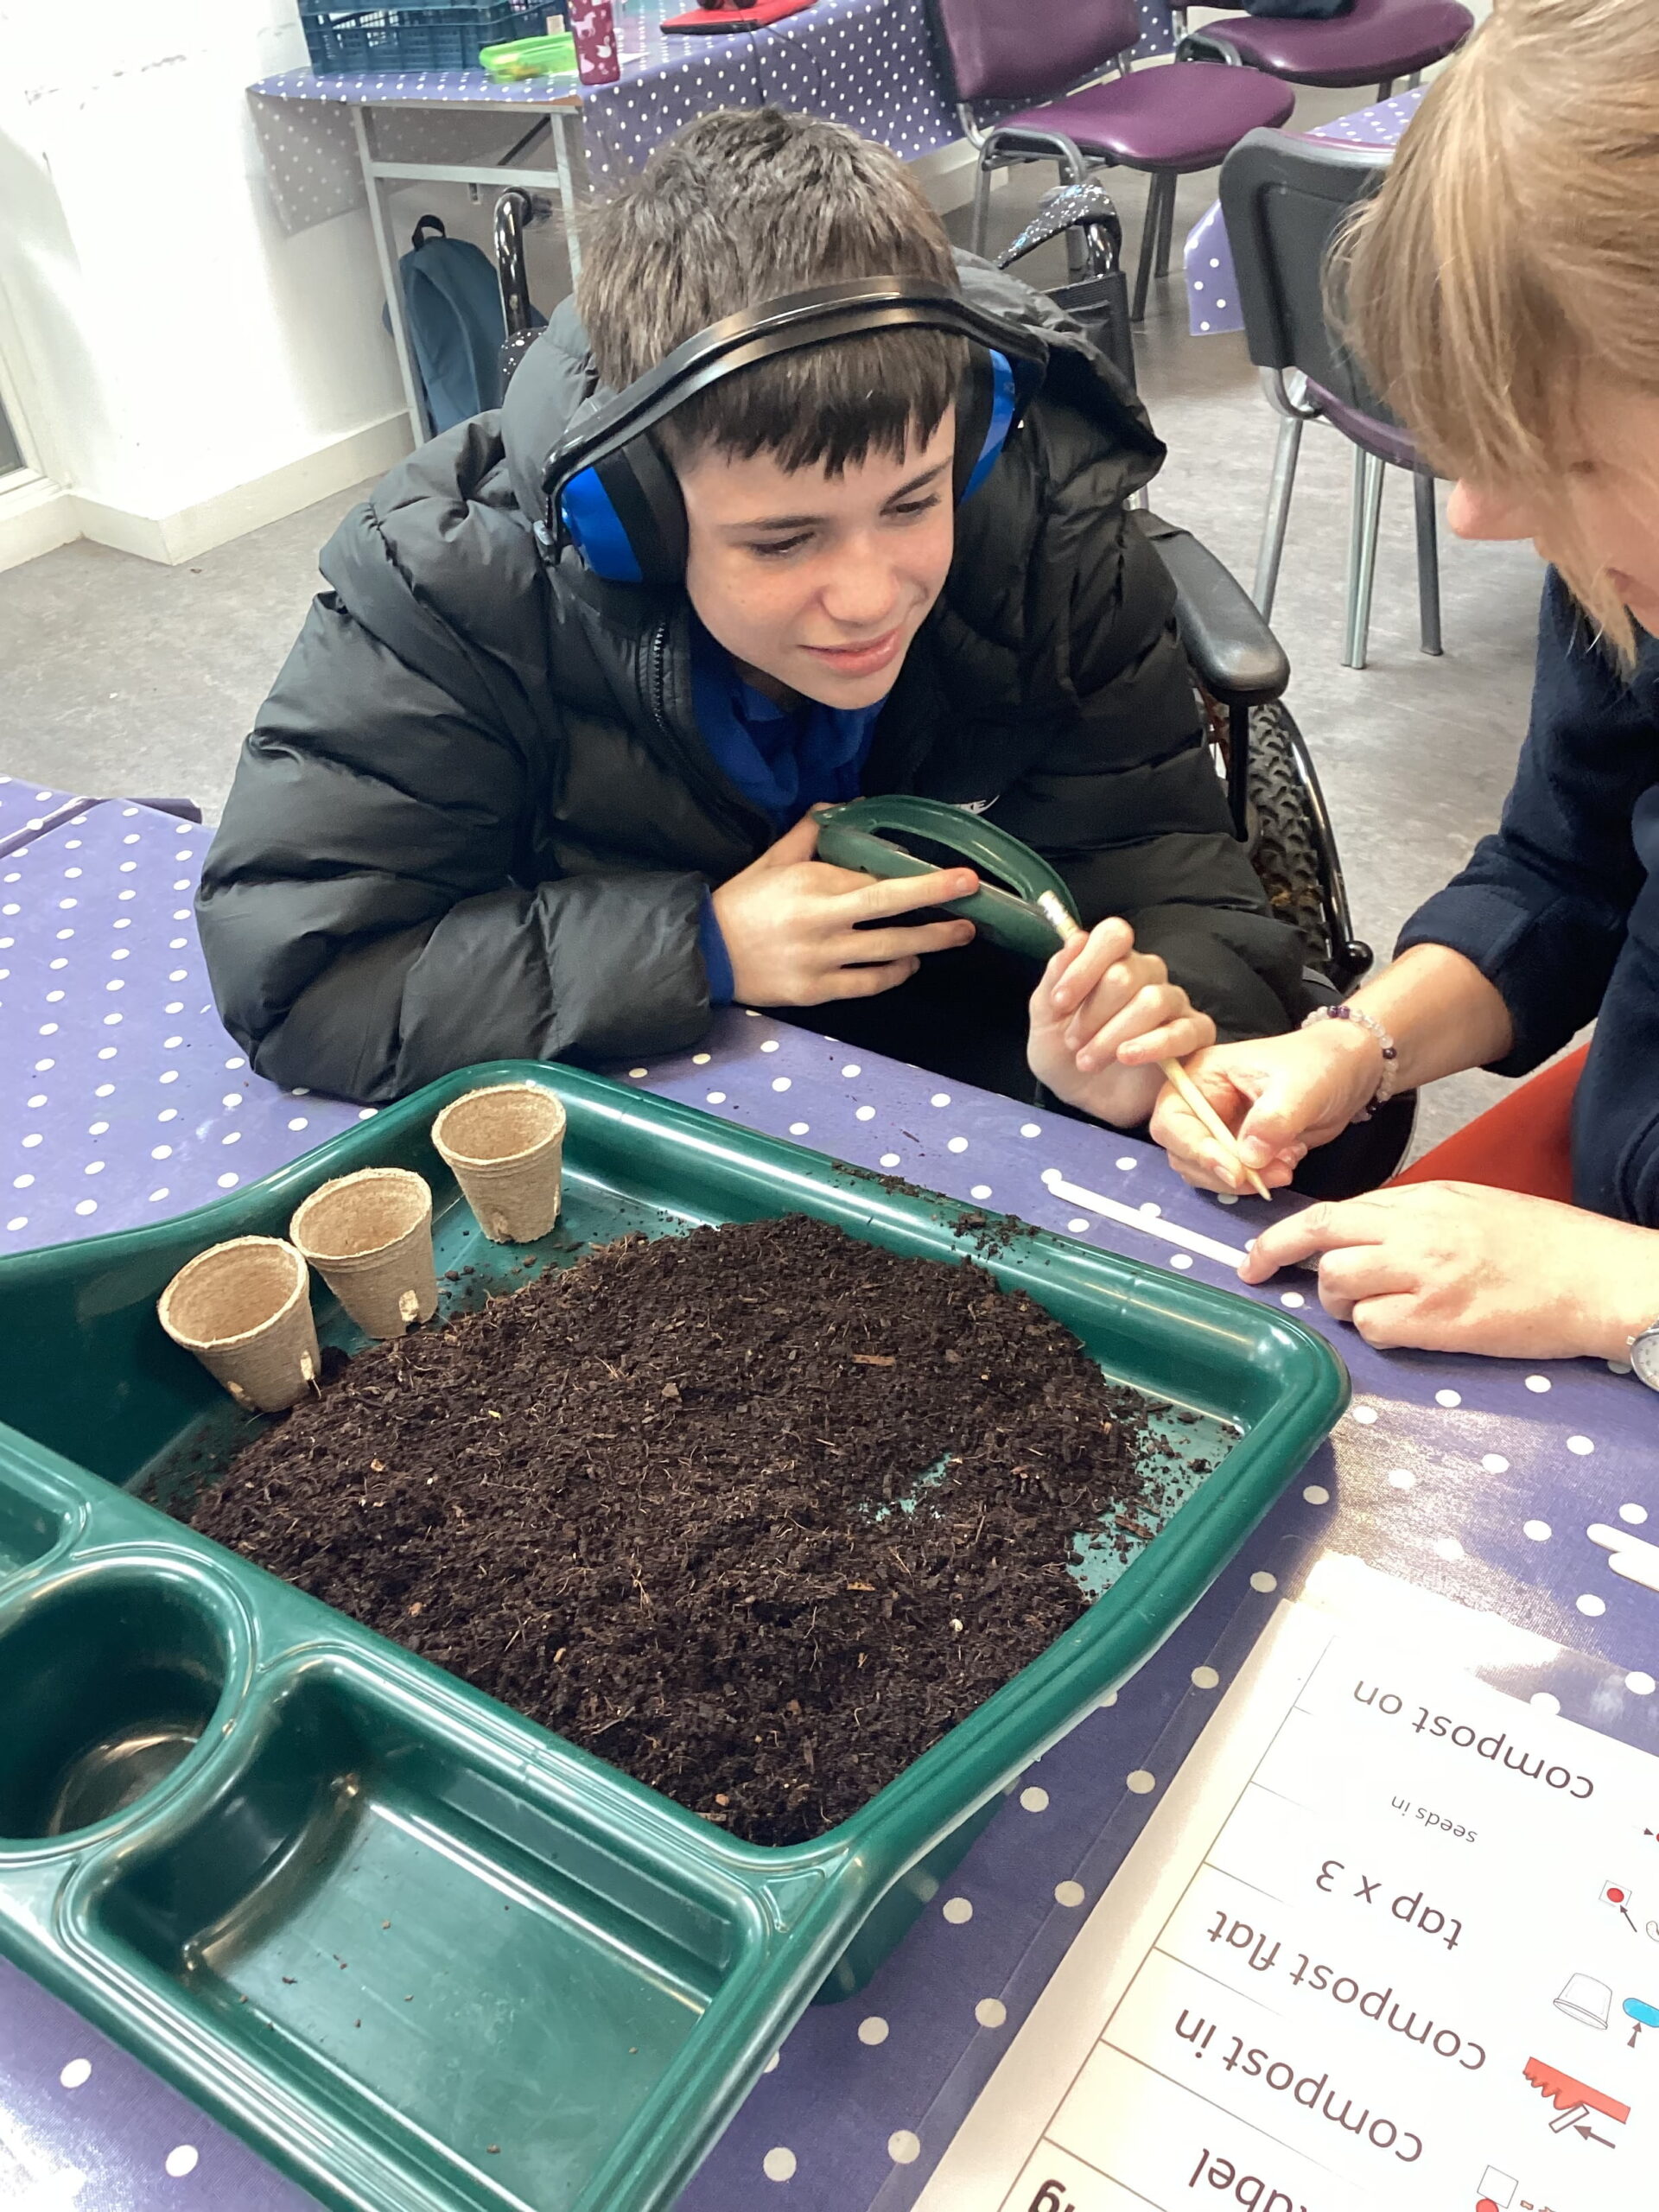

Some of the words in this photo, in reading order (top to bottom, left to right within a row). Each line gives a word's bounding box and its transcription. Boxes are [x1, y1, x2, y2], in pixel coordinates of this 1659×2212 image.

[1353, 1680, 1403, 1715] on
[1412, 1706, 1594, 1800] compost
[1390, 1795, 1412, 1815] in
[1414, 1802, 1478, 1843] seeds
[1315, 1859, 1345, 1893] 3
[1352, 1874, 1382, 1904] x
[1206, 1910, 1282, 1972] flat
[1391, 1891, 1463, 1951] tap
[1174, 2008, 1217, 2061] in
[1288, 1953, 1486, 2072] compost
[1222, 2036, 1423, 2163] compost
[1187, 2147, 1309, 2212] abel
